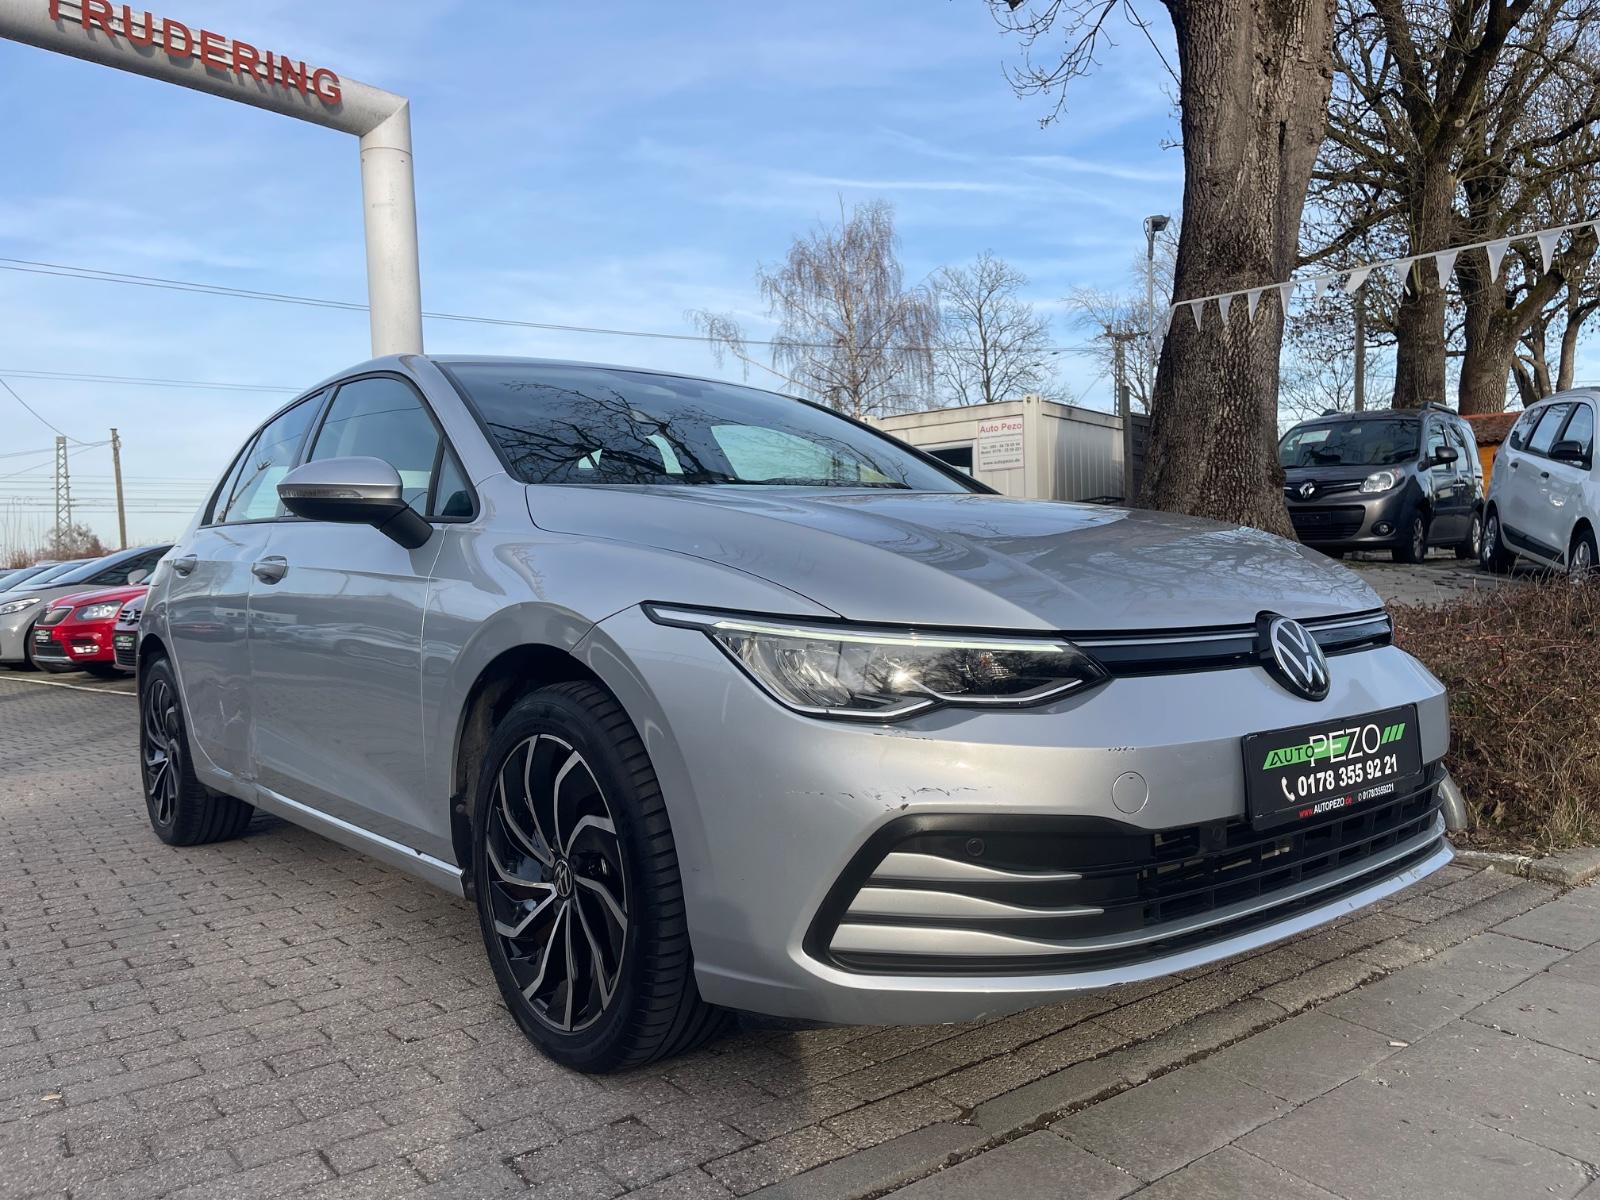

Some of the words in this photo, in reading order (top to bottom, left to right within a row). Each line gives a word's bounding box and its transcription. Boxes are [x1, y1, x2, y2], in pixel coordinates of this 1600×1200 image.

[980, 425, 999, 433] Auto
[1298, 771, 1335, 797] 0178
[1339, 763, 1363, 787] 355
[1366, 758, 1382, 780] 92
[1384, 754, 1398, 775] 21
